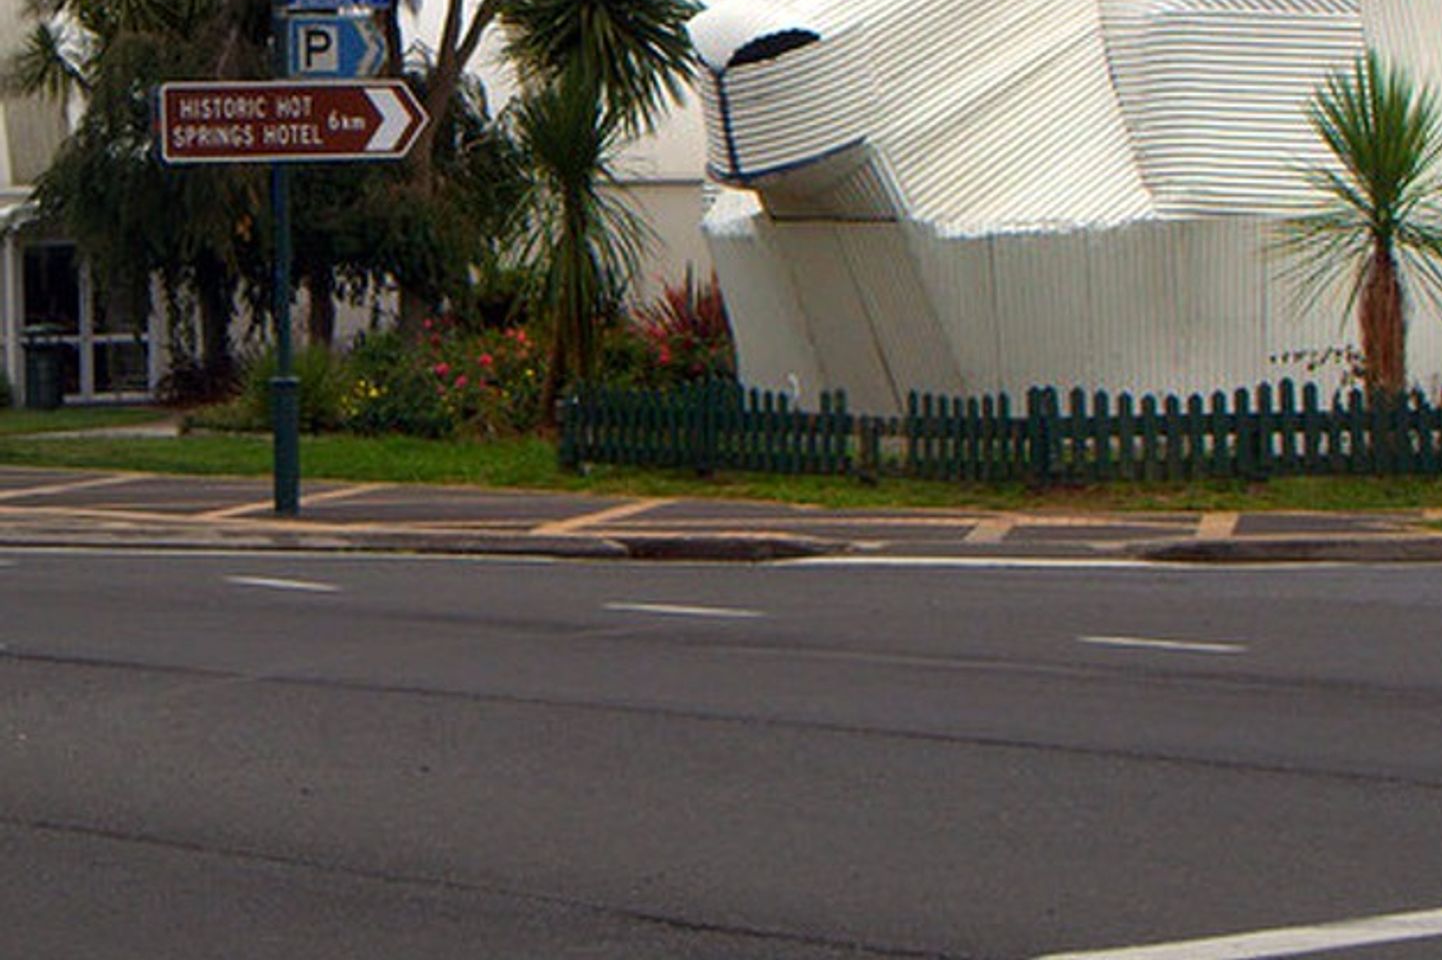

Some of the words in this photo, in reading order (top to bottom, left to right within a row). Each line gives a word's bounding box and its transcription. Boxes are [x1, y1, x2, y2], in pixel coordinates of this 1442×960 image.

[305, 30, 332, 67] P
[178, 96, 267, 120] HISTORIC
[275, 95, 314, 117] HOT
[327, 109, 366, 130] 6km
[172, 124, 255, 148] SPRINGS
[262, 123, 324, 145] HOTEL
